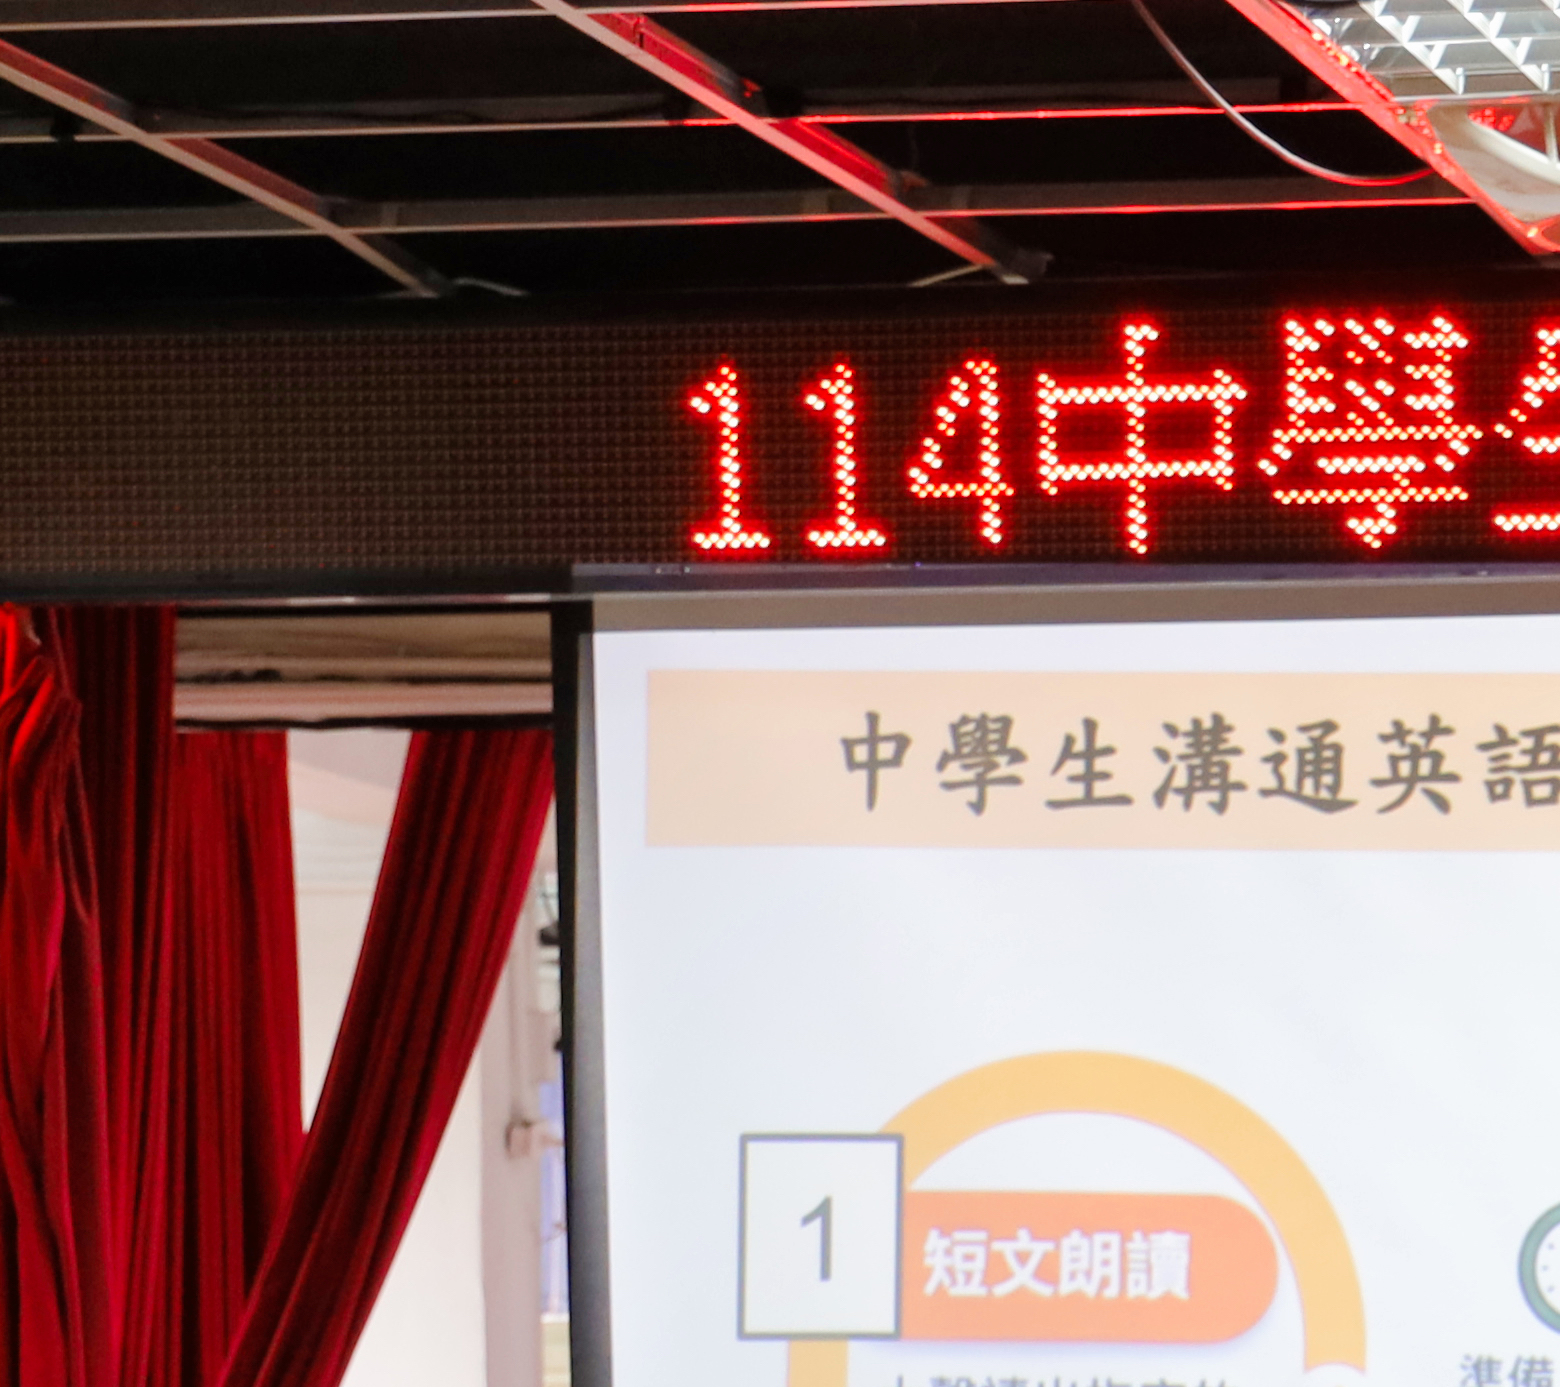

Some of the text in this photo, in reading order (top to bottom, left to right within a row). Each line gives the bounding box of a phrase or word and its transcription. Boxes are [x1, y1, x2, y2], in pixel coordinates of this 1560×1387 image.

[800, 1195, 833, 1282] 1
[923, 1227, 1192, 1300] 短文朗讀
